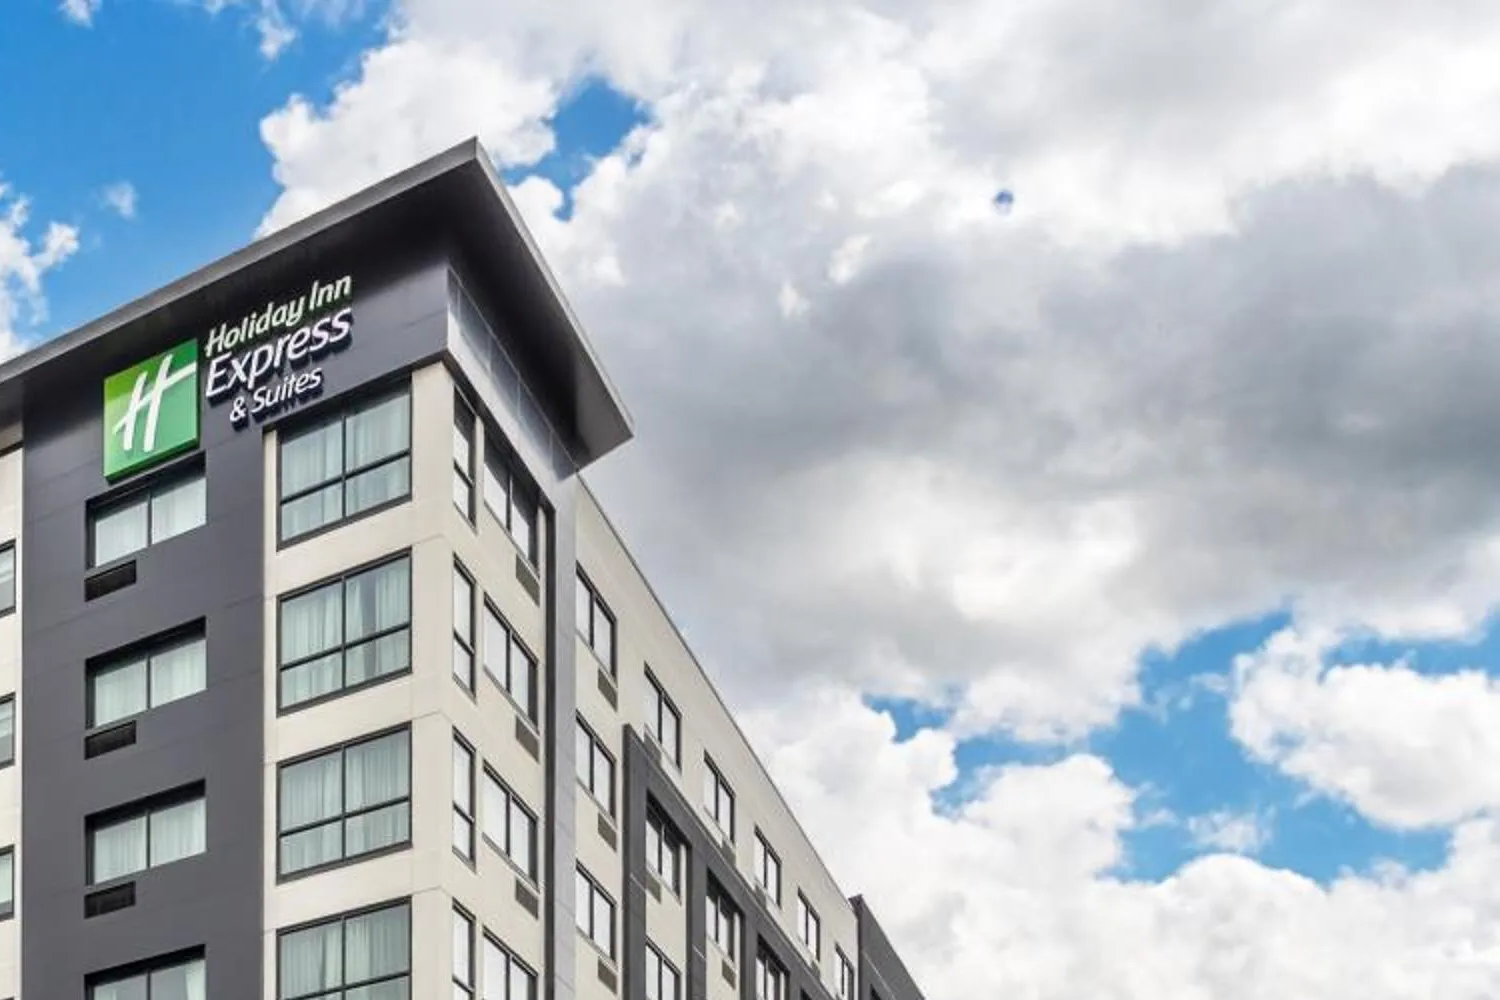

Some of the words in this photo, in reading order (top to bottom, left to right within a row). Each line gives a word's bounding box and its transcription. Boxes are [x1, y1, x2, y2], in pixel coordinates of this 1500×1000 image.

[205, 295, 305, 358] Holiday
[307, 274, 351, 312] Inn
[206, 307, 352, 398] Express
[228, 395, 247, 423] &
[250, 366, 324, 414] Suites
